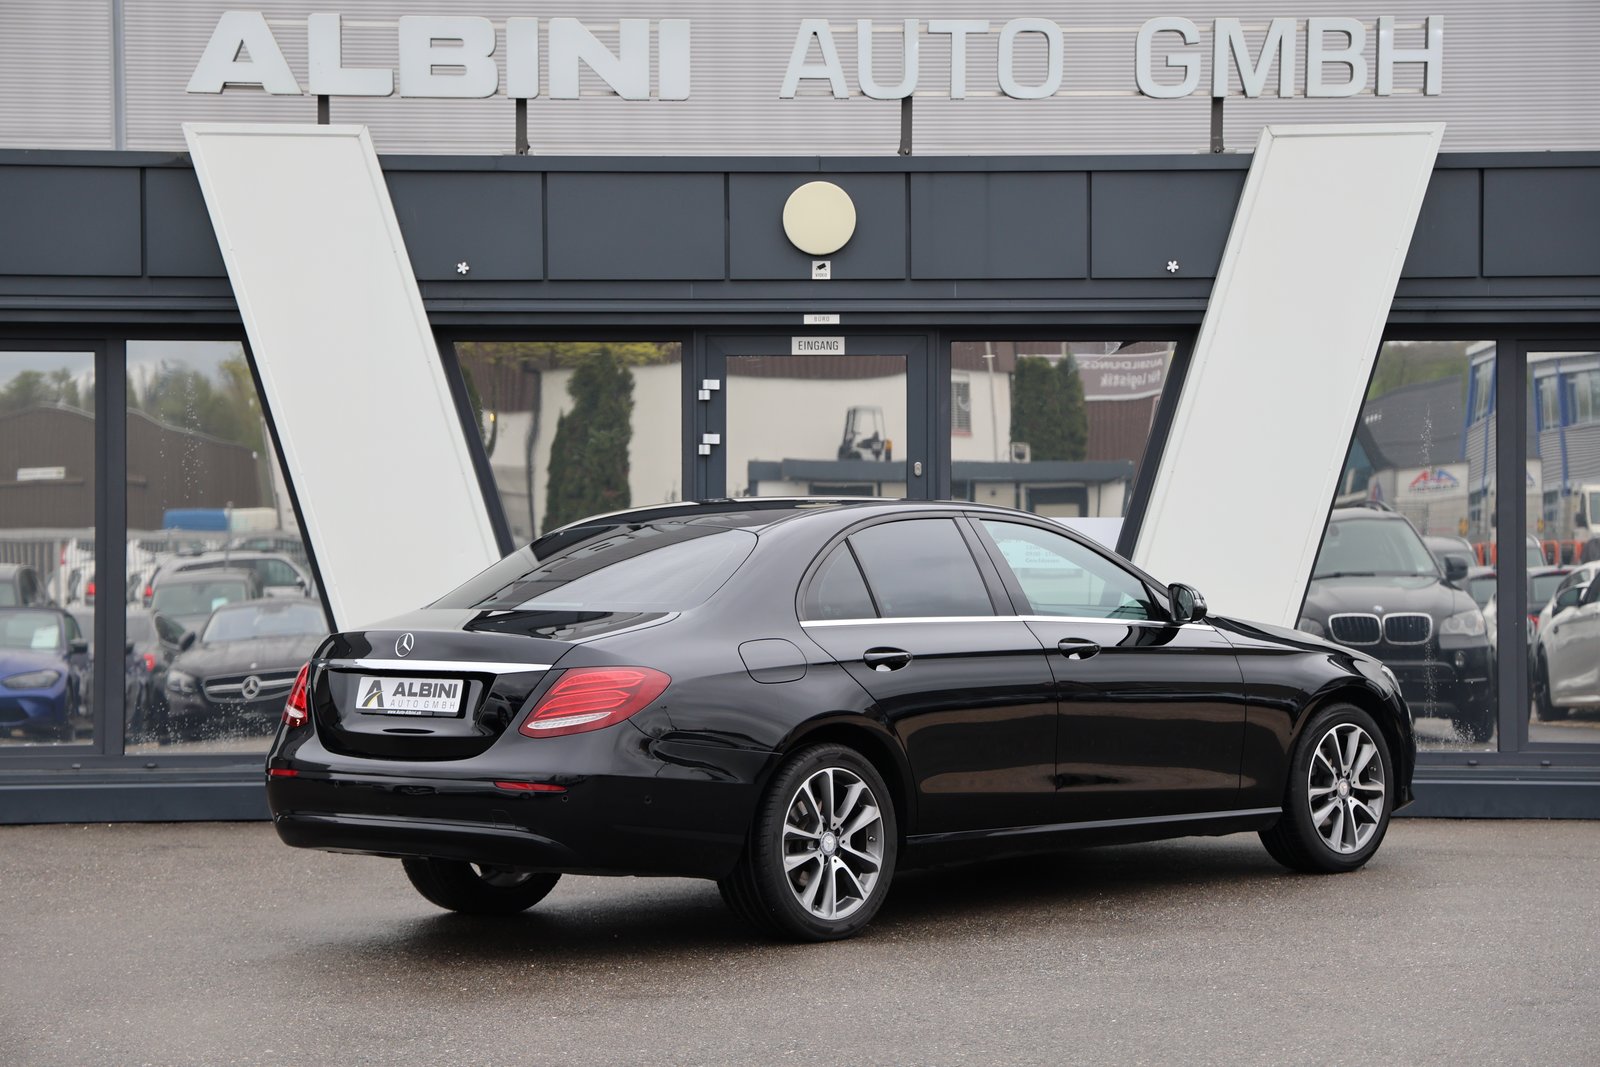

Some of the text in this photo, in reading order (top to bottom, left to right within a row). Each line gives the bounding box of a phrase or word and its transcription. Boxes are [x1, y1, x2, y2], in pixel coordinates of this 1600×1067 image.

[186, 11, 1444, 101] ALBINI AUTO GMBH
[798, 340, 839, 351] EINGANG
[392, 682, 458, 699] ALBINI
[389, 699, 456, 709] AUTO GMBH
